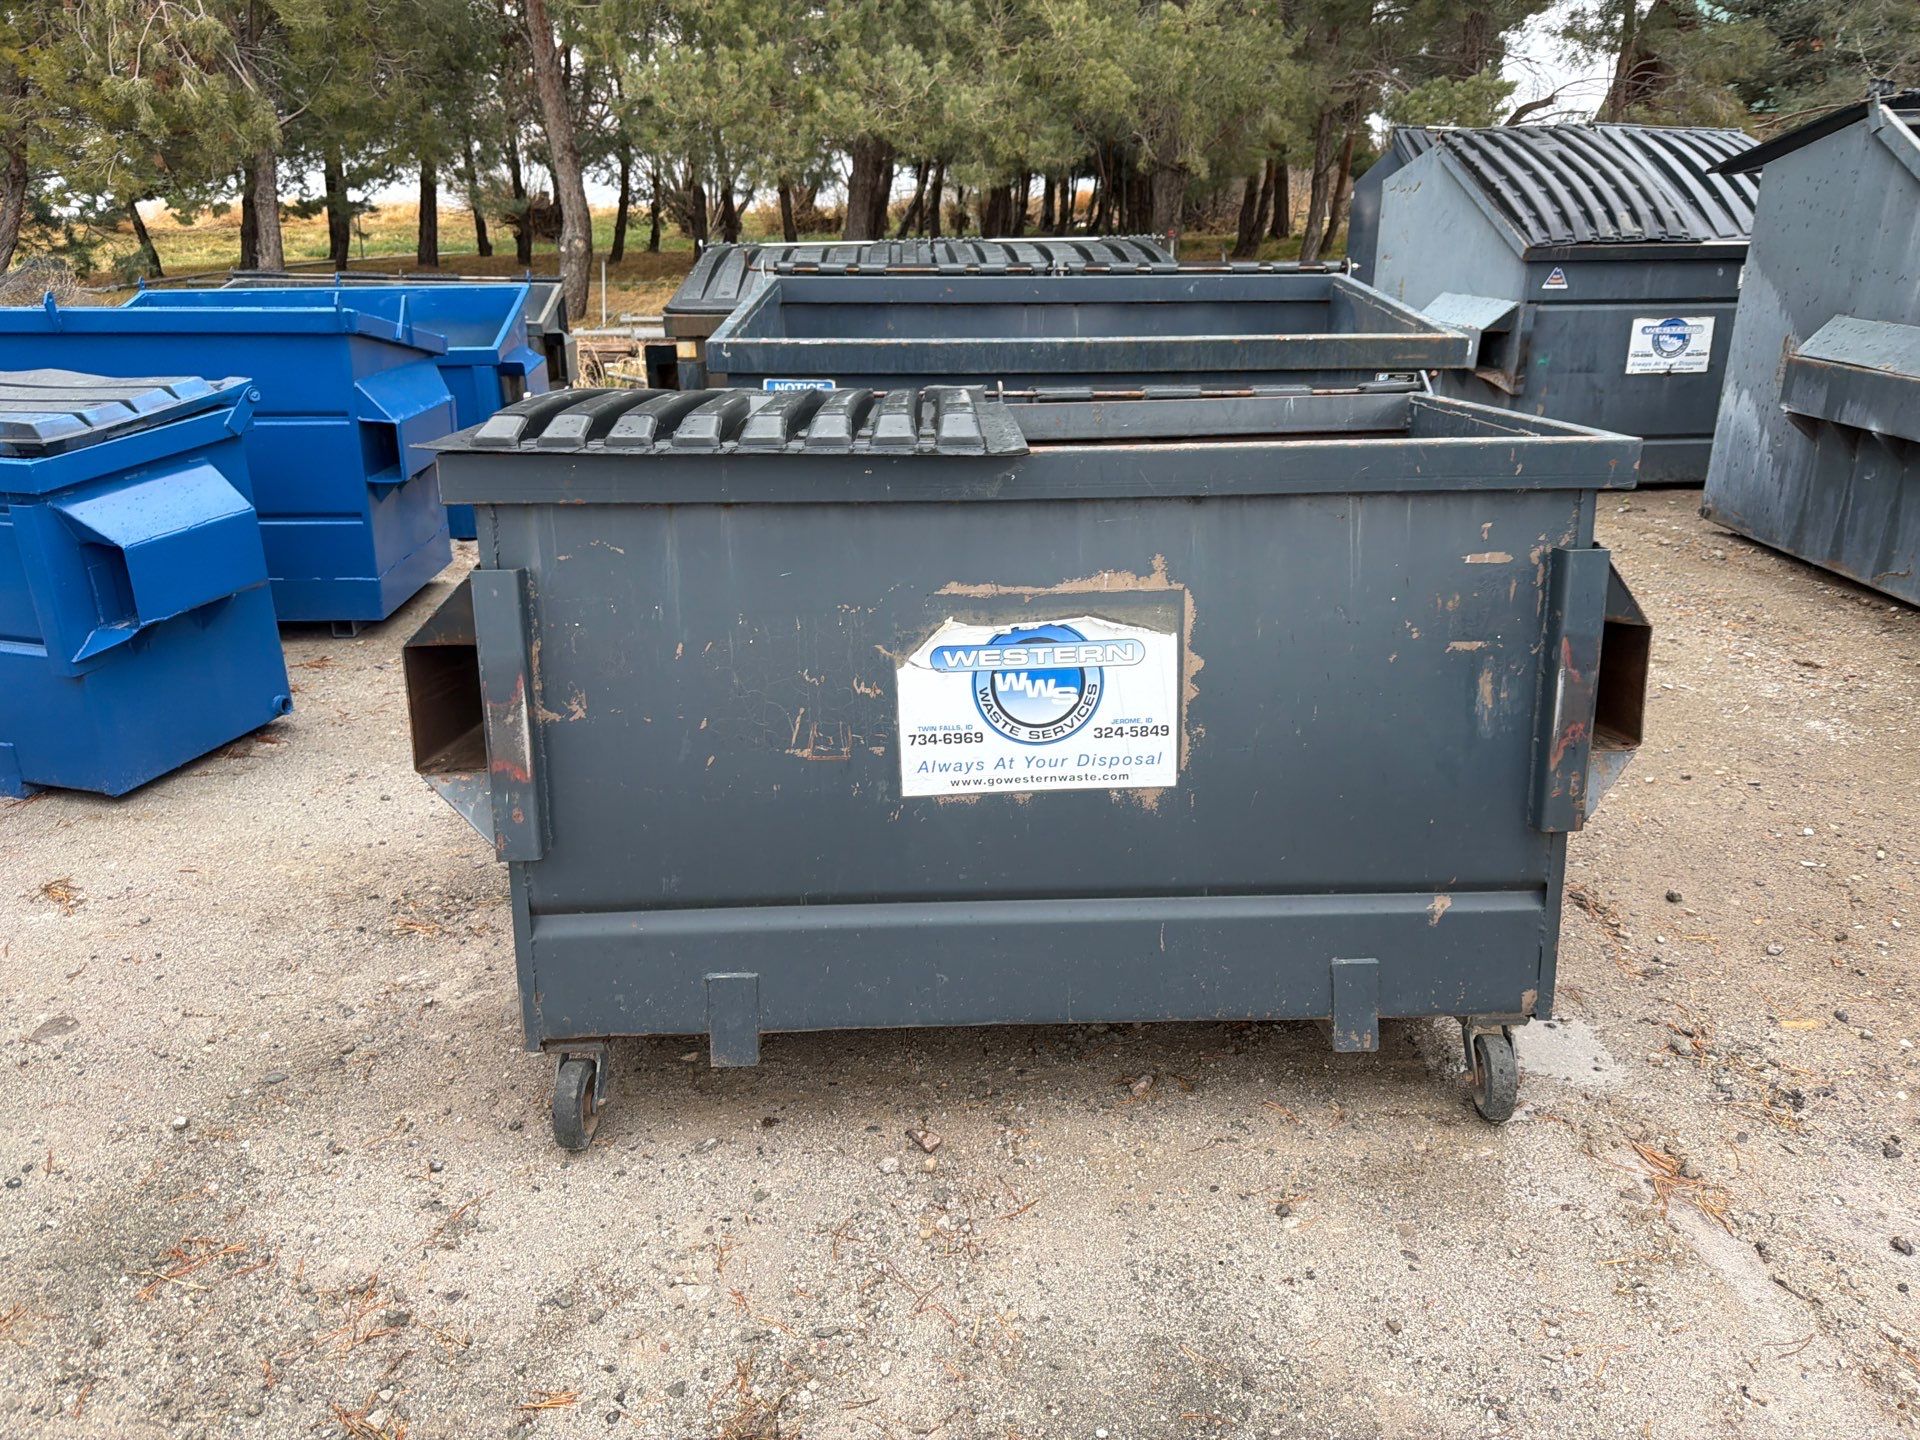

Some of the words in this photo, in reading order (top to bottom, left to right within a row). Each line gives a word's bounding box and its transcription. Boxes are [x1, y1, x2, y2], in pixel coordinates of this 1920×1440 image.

[942, 642, 1135, 668] WESTERN
[994, 672, 1079, 705] WWS
[979, 687, 1021, 737] WASTE
[1028, 683, 1098, 740] SERVICES
[908, 732, 984, 746] 734-6969
[1093, 725, 1170, 739] 324-5849
[917, 757, 984, 774] Always
[994, 757, 1015, 770] At
[1025, 755, 1068, 769] Your
[1077, 752, 1162, 769] Disposal
[950, 772, 1130, 787] www.gowesternwaste.com
